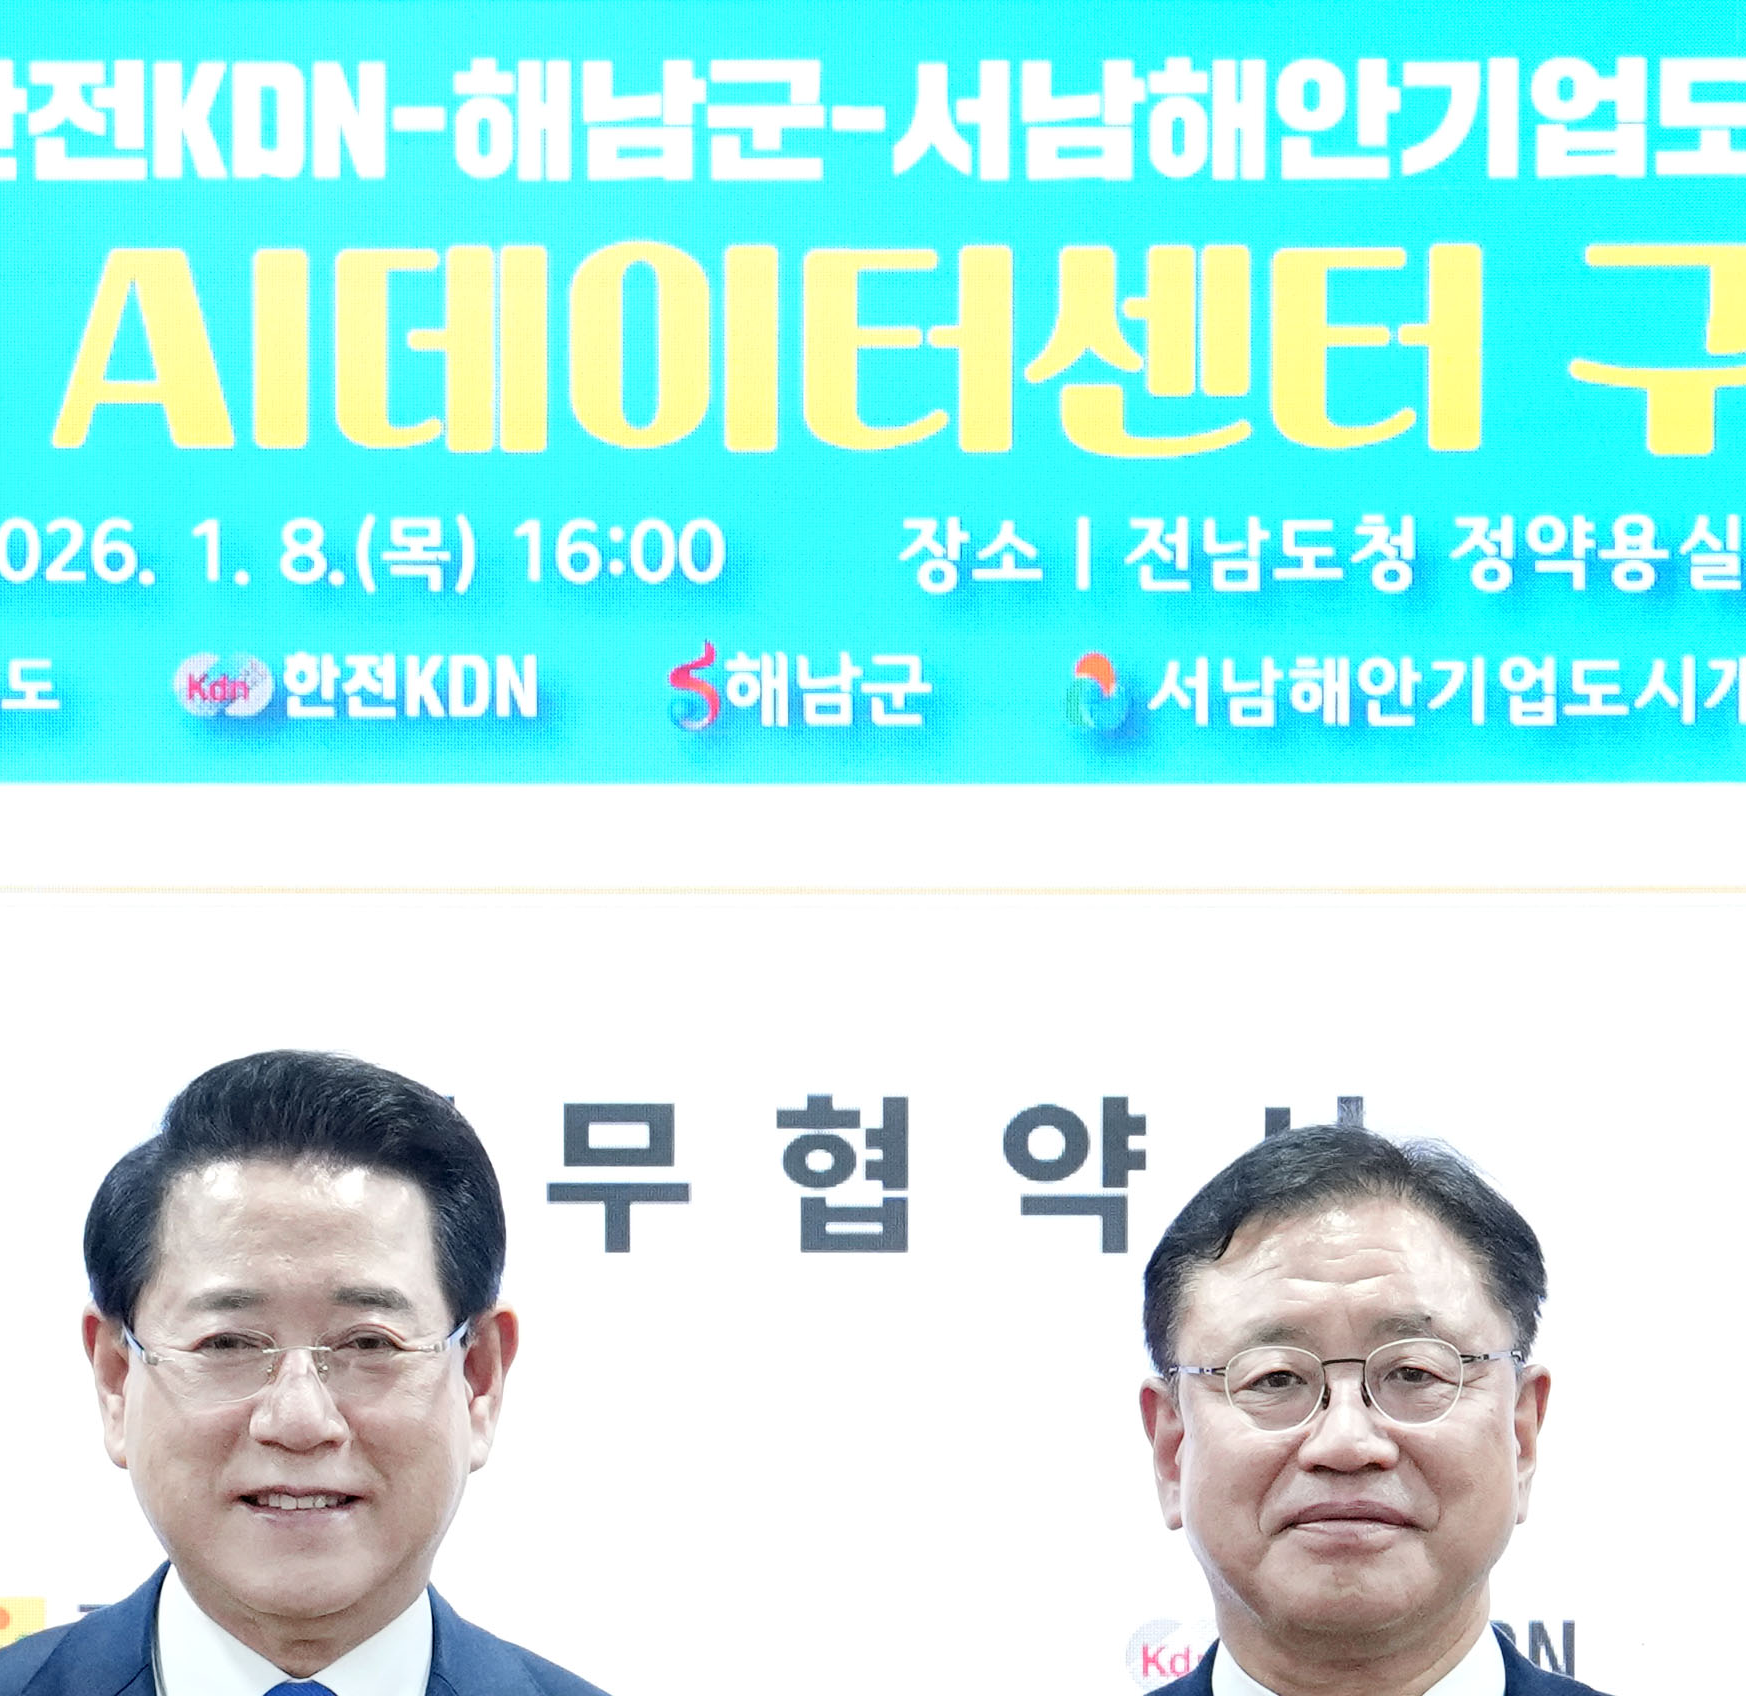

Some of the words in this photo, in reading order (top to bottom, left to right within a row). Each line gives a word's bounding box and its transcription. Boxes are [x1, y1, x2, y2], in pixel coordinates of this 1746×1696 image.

[51, 239, 1483, 459] AI데이터센터
[193, 519, 249, 585] 1.
[280, 514, 475, 593] 8.(목)
[515, 518, 725, 583] 16:00
[899, 516, 1043, 593] 장소
[1125, 514, 1414, 592] 전남도청
[283, 651, 537, 718] 한전KDN
[726, 651, 932, 727] 해남군
